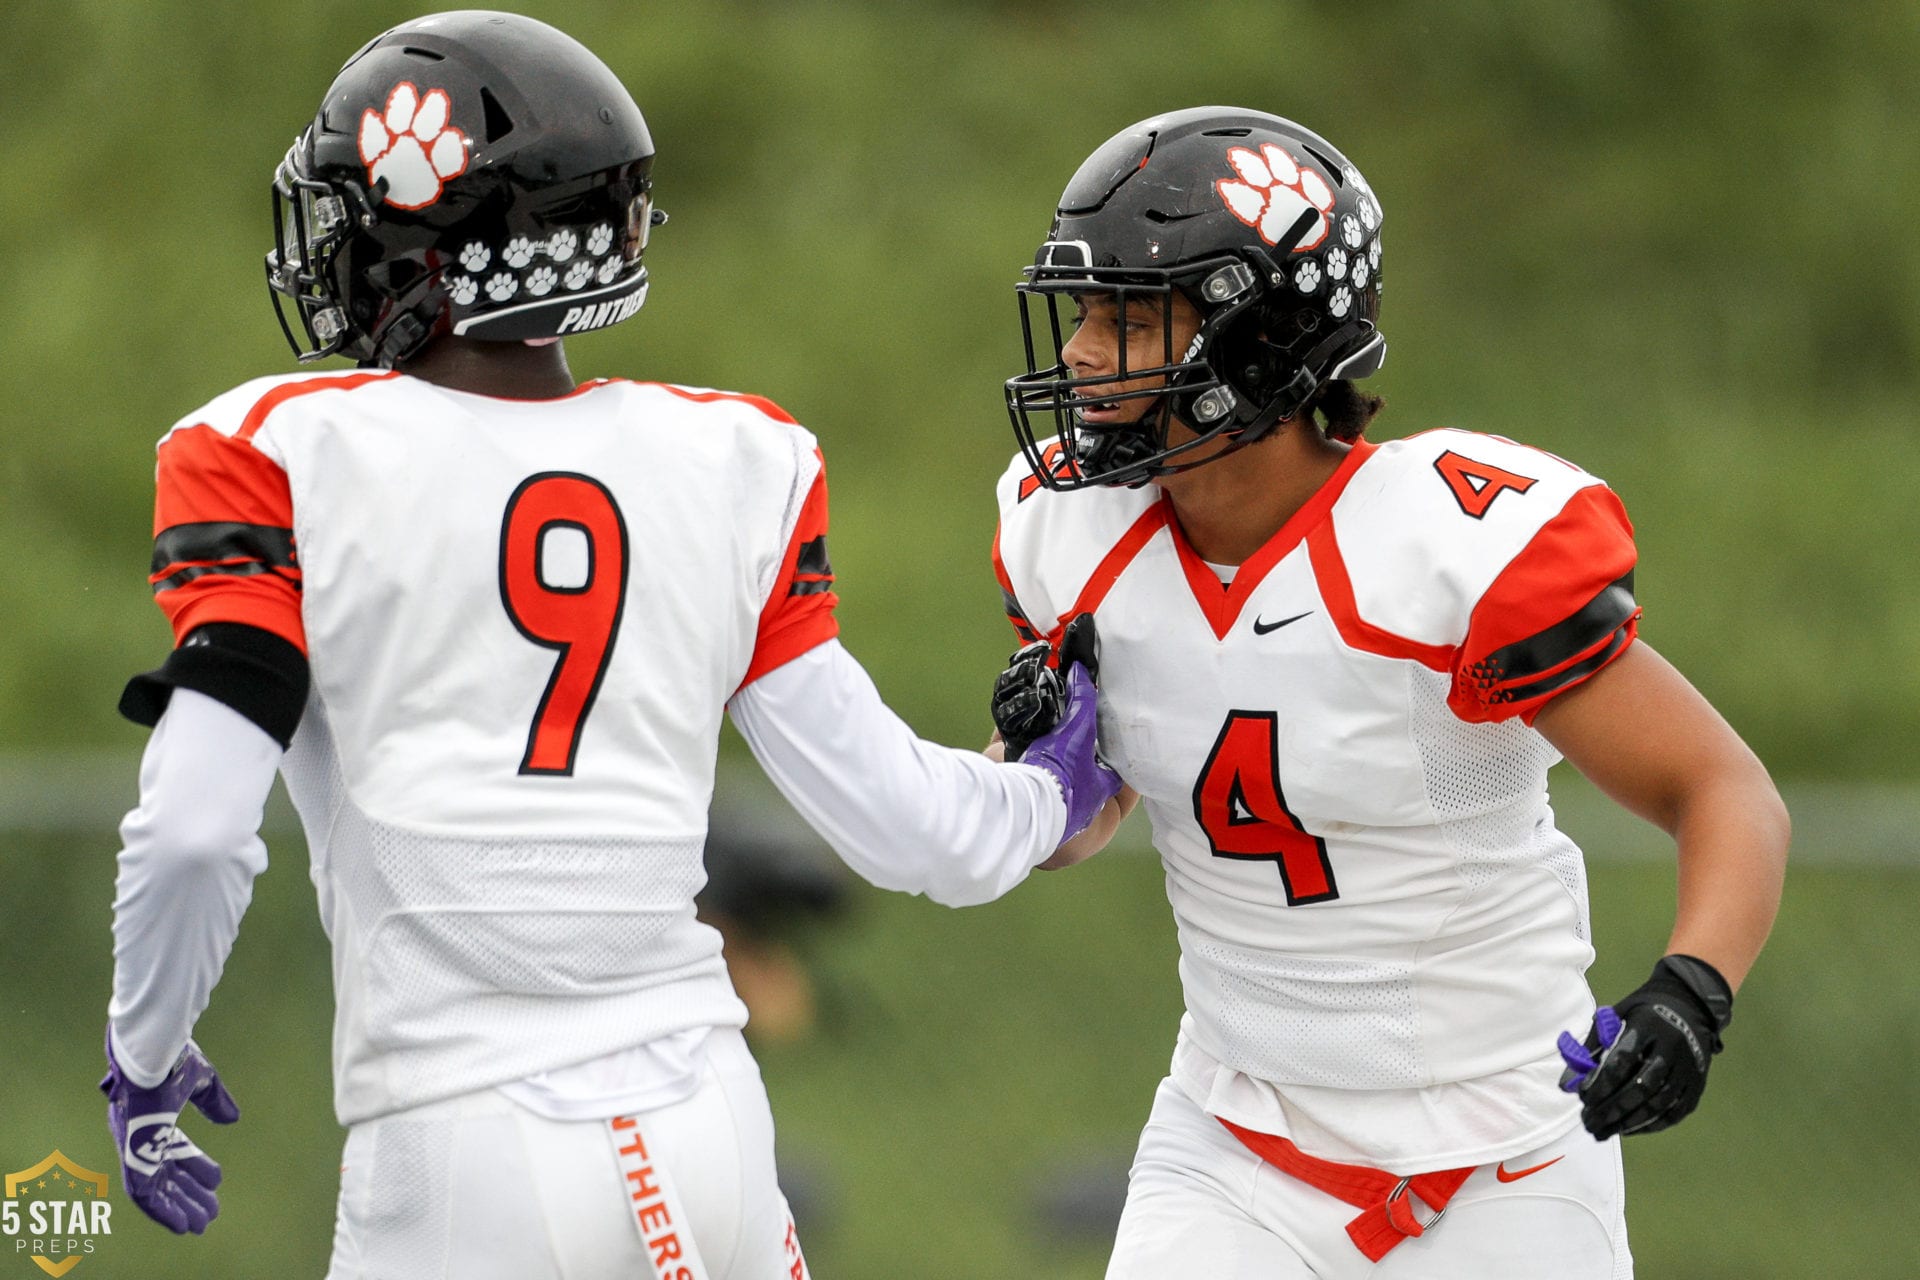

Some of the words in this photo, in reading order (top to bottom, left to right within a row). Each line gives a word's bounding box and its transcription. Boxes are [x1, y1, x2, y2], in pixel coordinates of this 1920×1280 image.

[1432, 449, 1539, 520] 4
[499, 471, 629, 777] 9
[1192, 709, 1340, 907] 4
